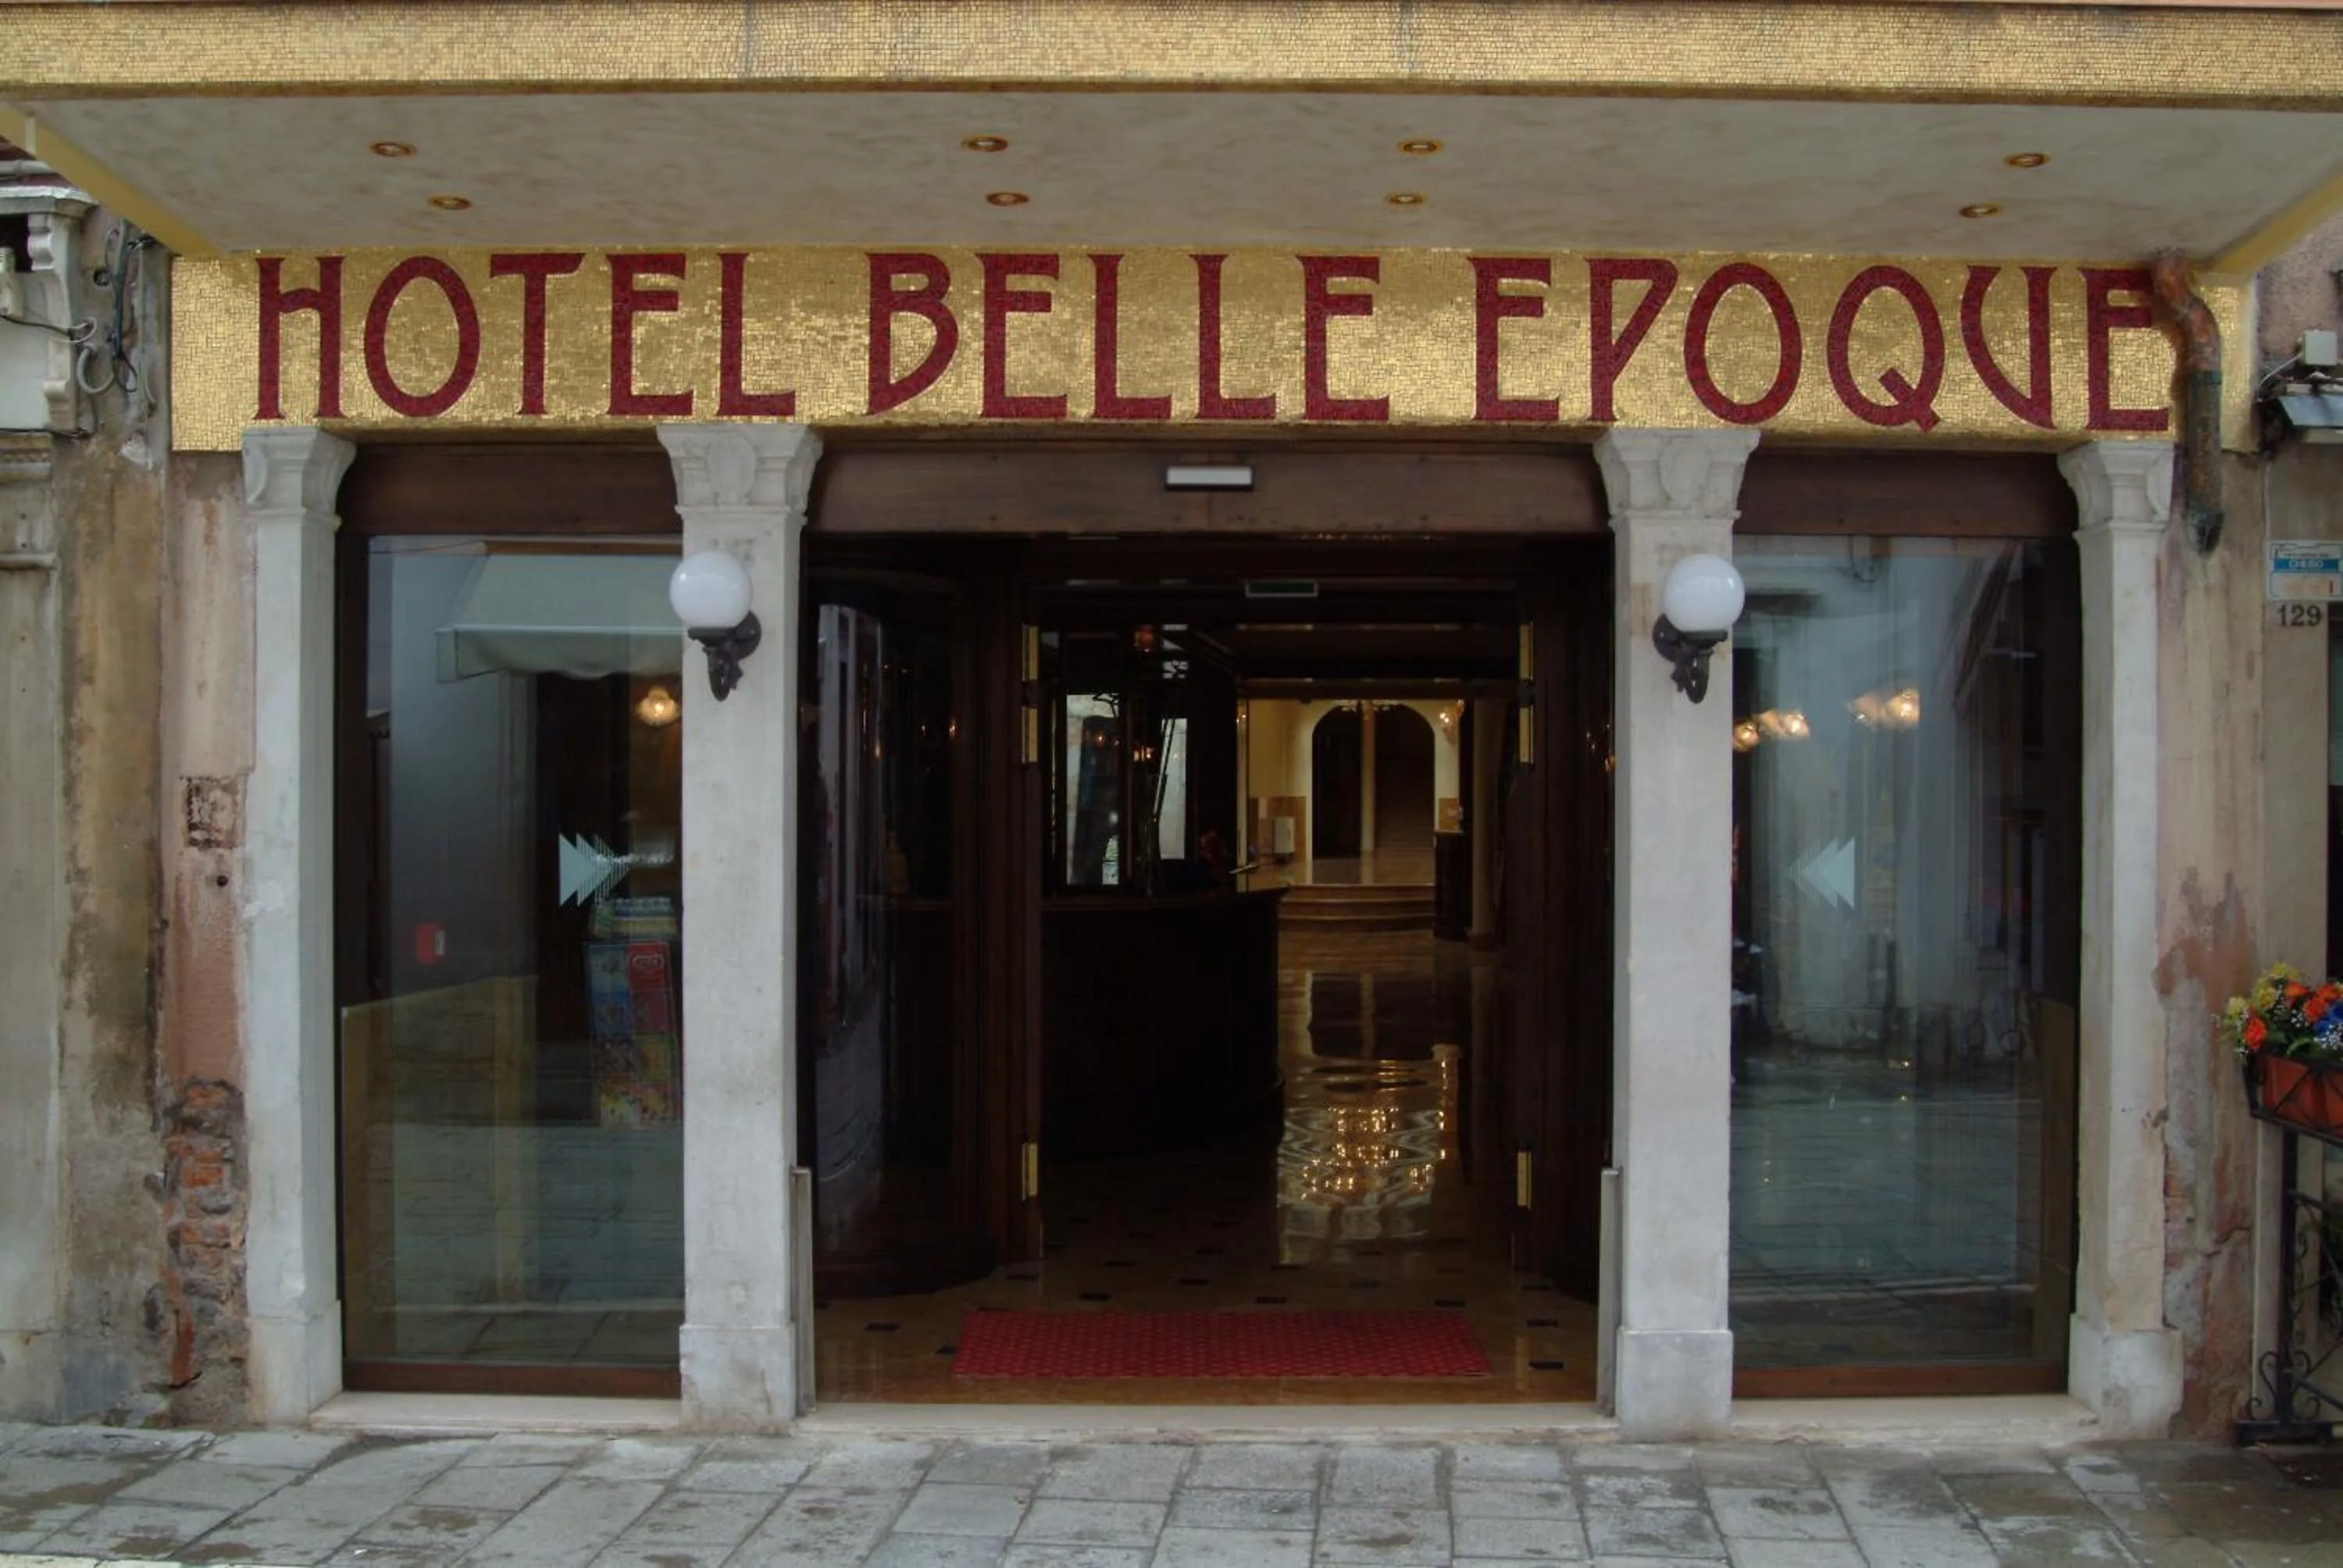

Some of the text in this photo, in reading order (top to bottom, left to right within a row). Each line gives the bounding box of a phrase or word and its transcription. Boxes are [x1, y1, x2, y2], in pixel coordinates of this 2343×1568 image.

[256, 253, 2173, 433] HOTEL BELLE EPOQUE
[2277, 603, 2323, 628] 129
